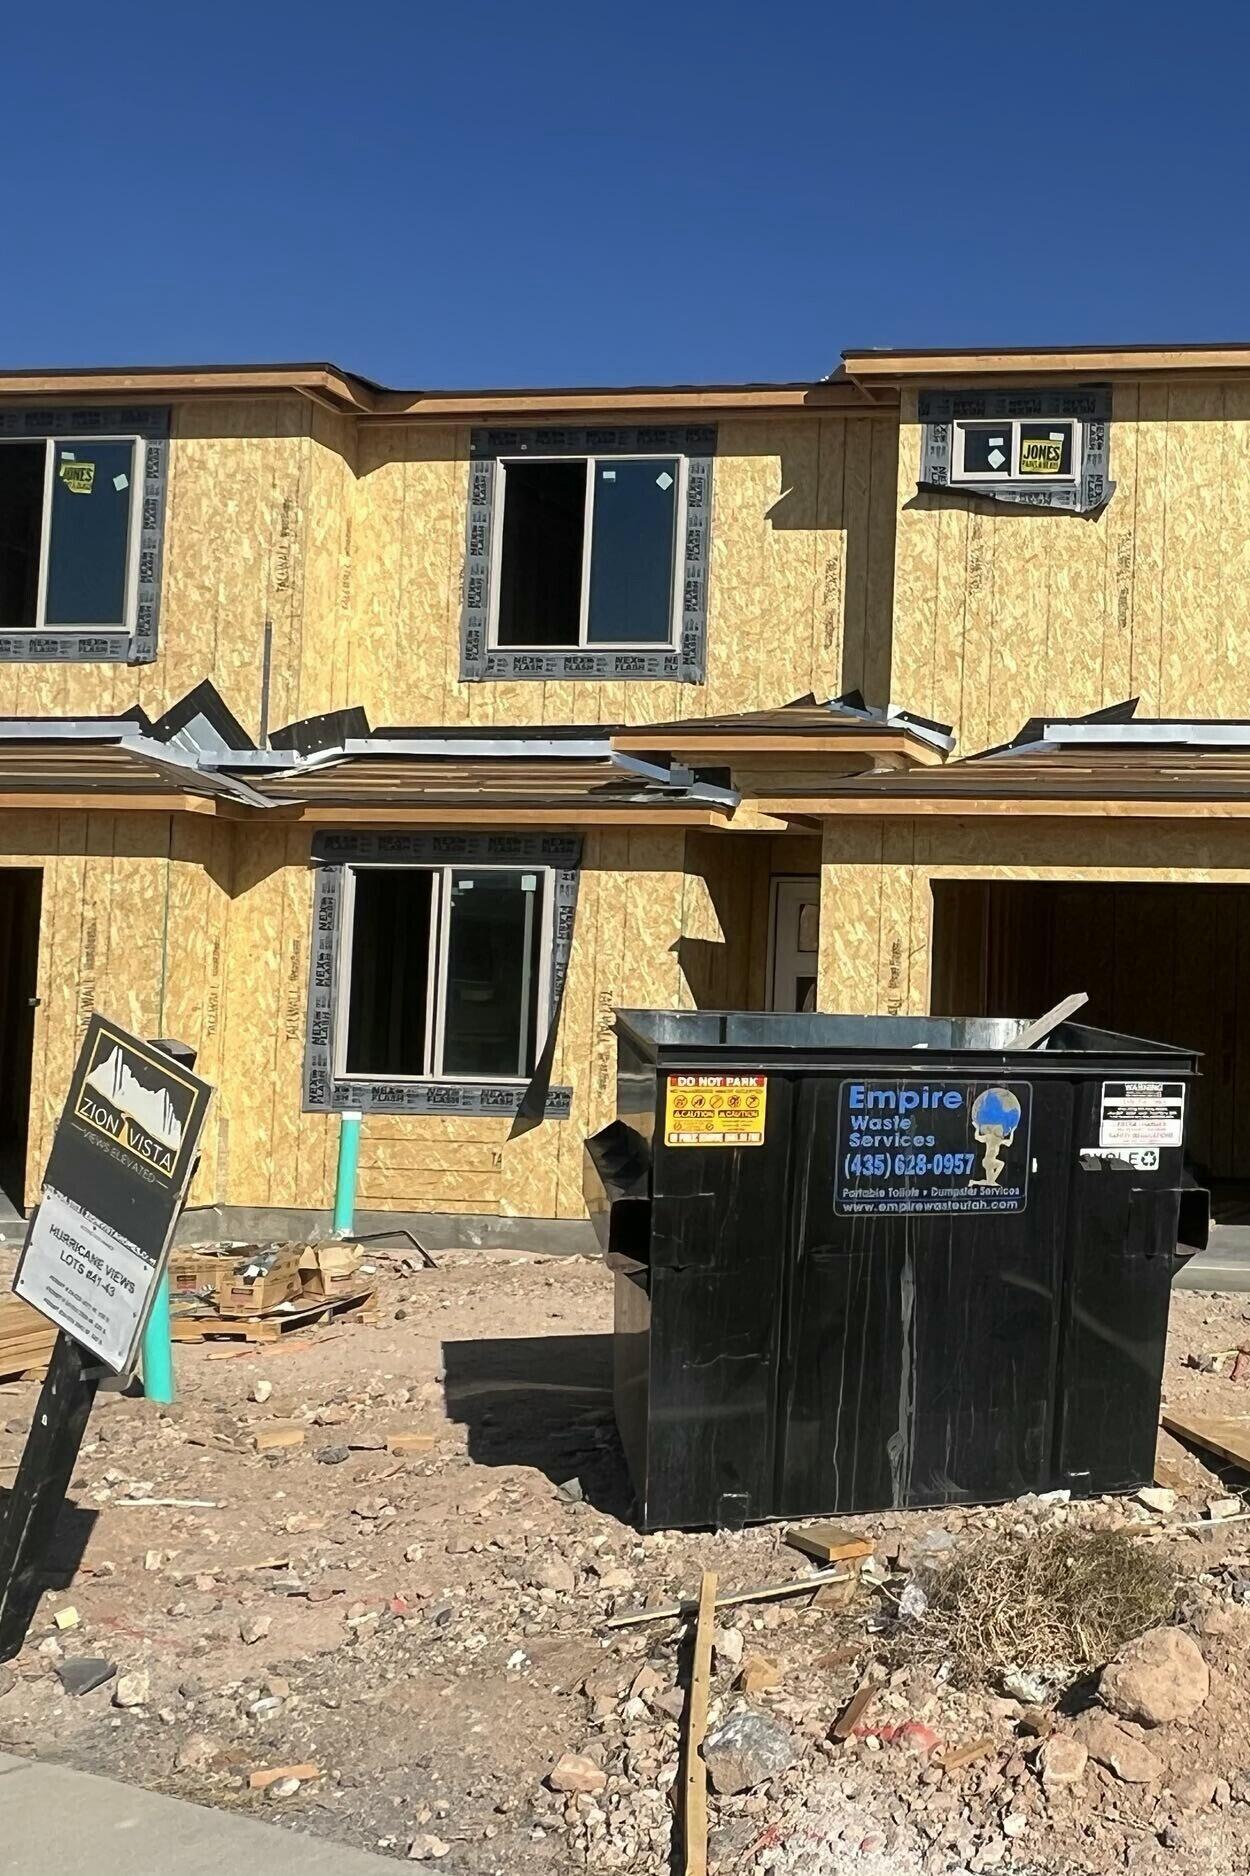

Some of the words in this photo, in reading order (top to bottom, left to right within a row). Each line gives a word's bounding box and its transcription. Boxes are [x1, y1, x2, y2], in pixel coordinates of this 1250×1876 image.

[1023, 445, 1060, 462] JONES
[312, 1020, 321, 1045] NEX
[309, 1077, 317, 1104] NEX
[315, 1070, 325, 1104] FLASH
[677, 1076, 695, 1087] DO
[698, 1076, 722, 1087] NOT
[725, 1076, 758, 1087] PARK
[849, 1085, 964, 1114] Empire
[682, 1110, 713, 1118] CAUTION
[850, 1115, 912, 1131] Waste
[80, 1097, 120, 1134] ZION
[128, 1127, 171, 1172] VISTA
[849, 1132, 936, 1148] Services
[110, 1147, 156, 1183] ELEVATED
[844, 1152, 892, 1180] (435)
[894, 1153, 975, 1176] 628-0957
[842, 1187, 885, 1198] Portable
[888, 1186, 920, 1197] Toilets
[931, 1187, 977, 1198] Dumpster
[979, 1186, 1020, 1196] Services
[842, 1200, 1018, 1213] www.empirewasteutah.com
[49, 1224, 105, 1271] HURRICANE
[105, 1263, 136, 1294] VIEWS
[59, 1250, 84, 1276] LOTS
